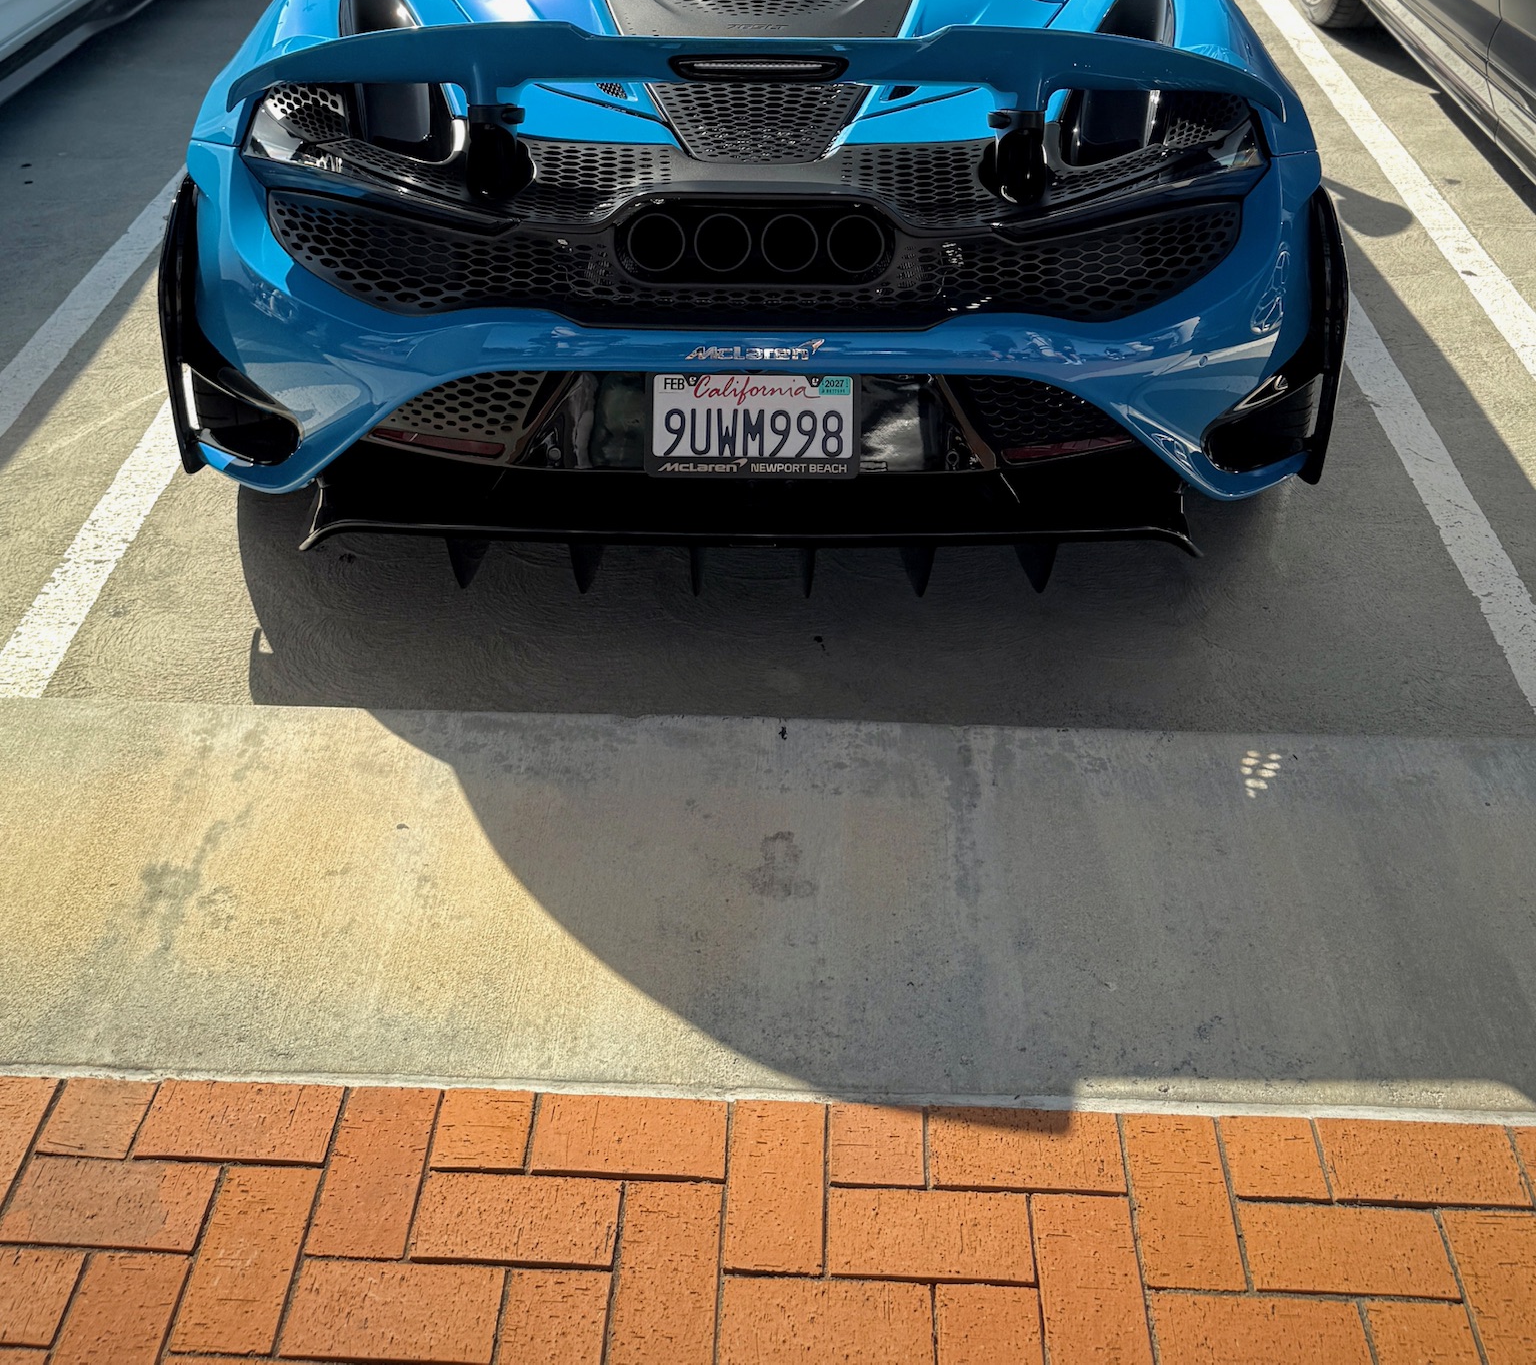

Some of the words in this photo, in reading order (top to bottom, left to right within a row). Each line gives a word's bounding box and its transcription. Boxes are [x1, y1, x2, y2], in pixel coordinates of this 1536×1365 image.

[685, 344, 812, 360] McLaren
[664, 378, 685, 390] FEB
[693, 375, 821, 405] California
[825, 379, 845, 388] 2027
[663, 408, 844, 457] 9UWM998
[657, 461, 741, 473] McLaren
[750, 463, 807, 473] NEWPORT
[808, 463, 848, 473] BEACH
